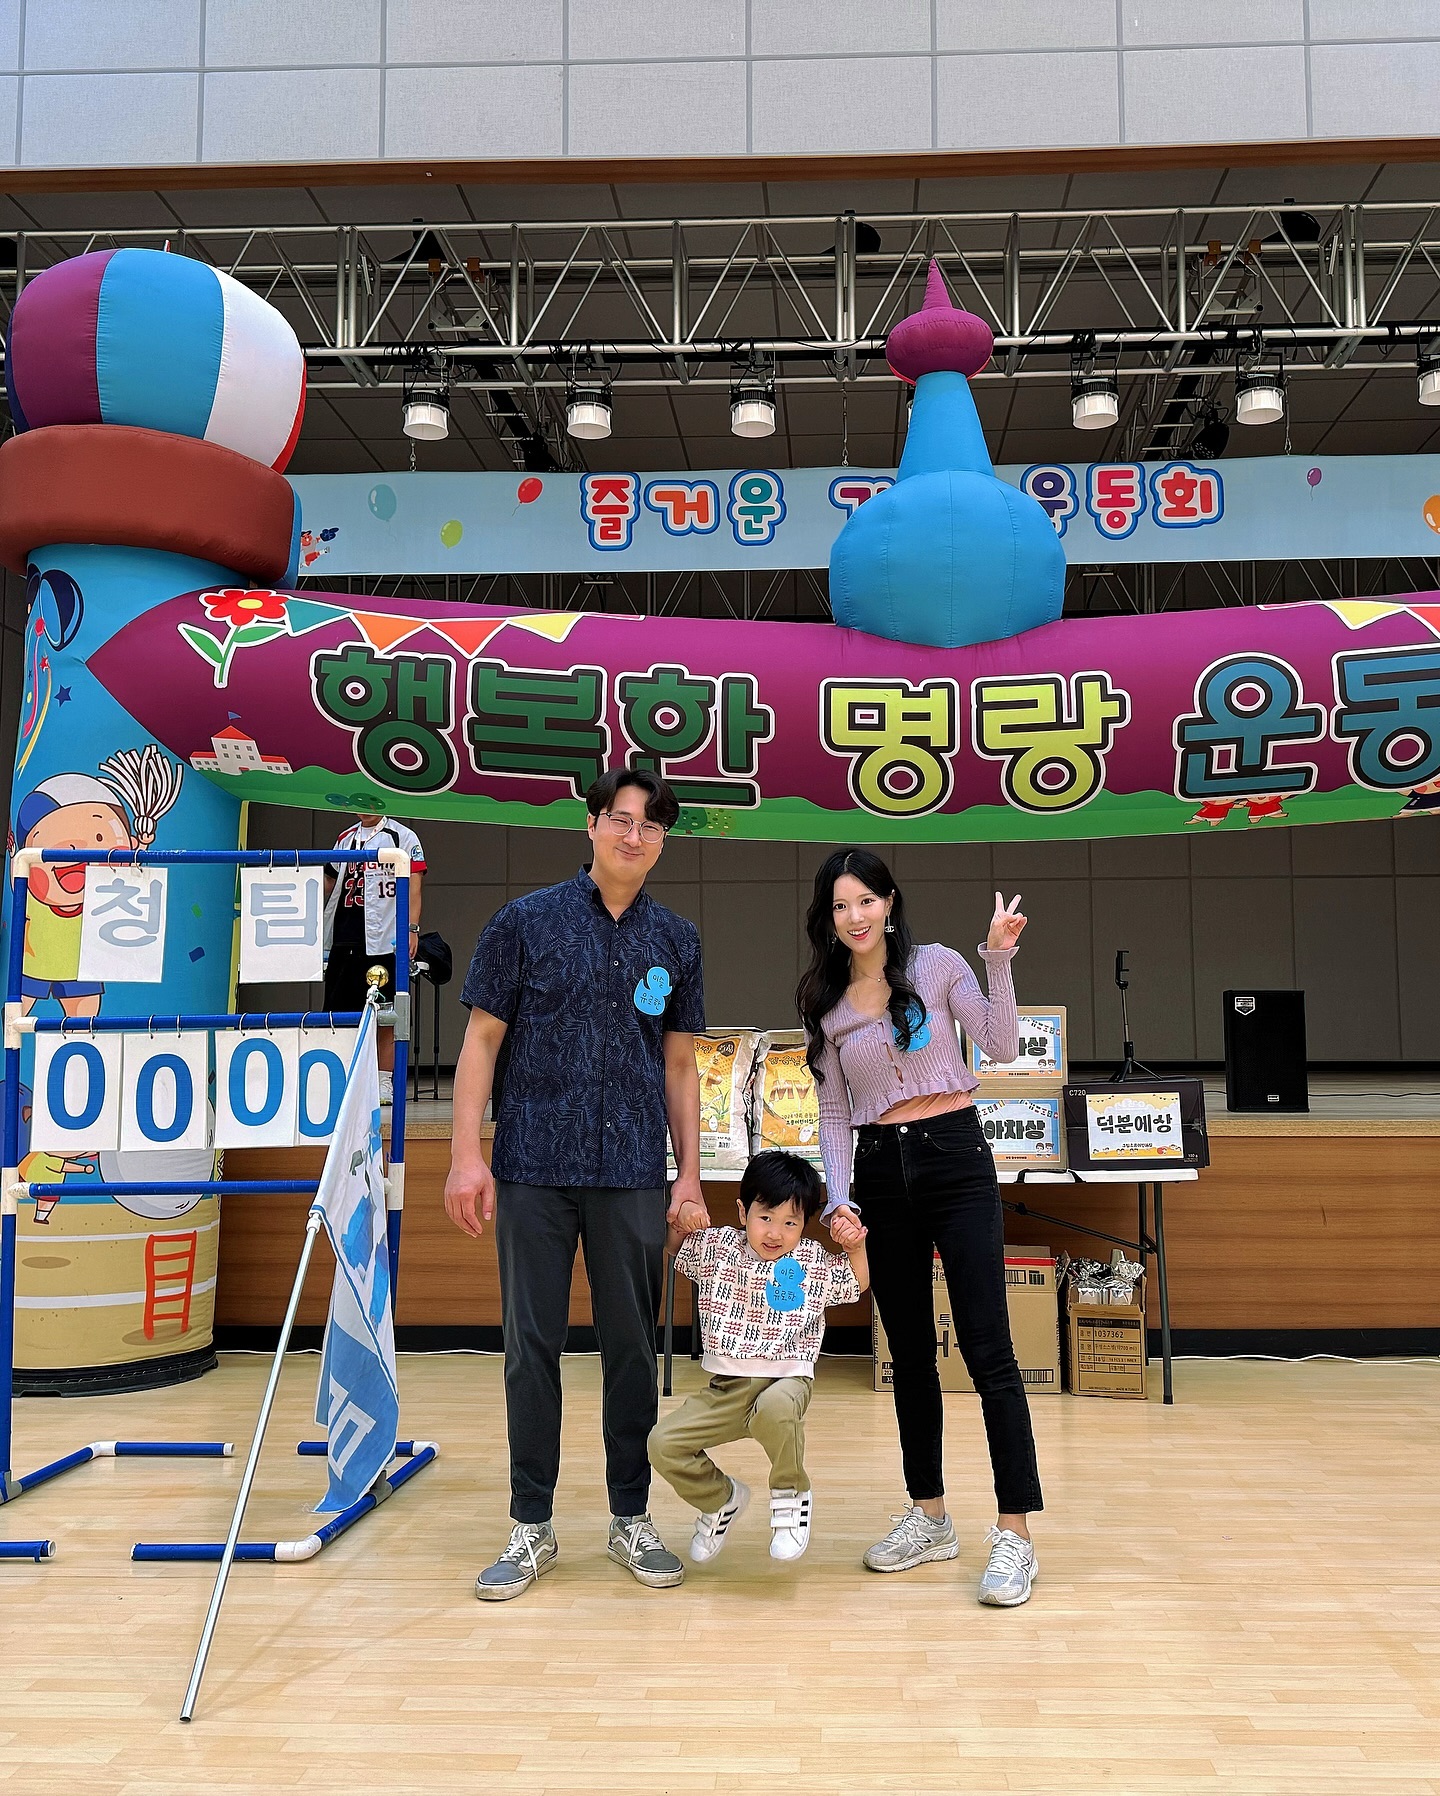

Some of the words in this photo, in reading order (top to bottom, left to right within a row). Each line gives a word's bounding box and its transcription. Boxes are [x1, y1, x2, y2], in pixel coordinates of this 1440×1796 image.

[581, 470, 786, 551] 즐거운
[312, 645, 776, 808] 행복한
[820, 670, 1131, 818] 명랑
[91, 878, 163, 947] 청
[250, 878, 320, 949] 팀
[769, 1079, 816, 1101] MV
[983, 1119, 1046, 1140] 아차상
[1096, 1113, 1173, 1134] 덕분에상
[1094, 1330, 1124, 1338] 1037362
